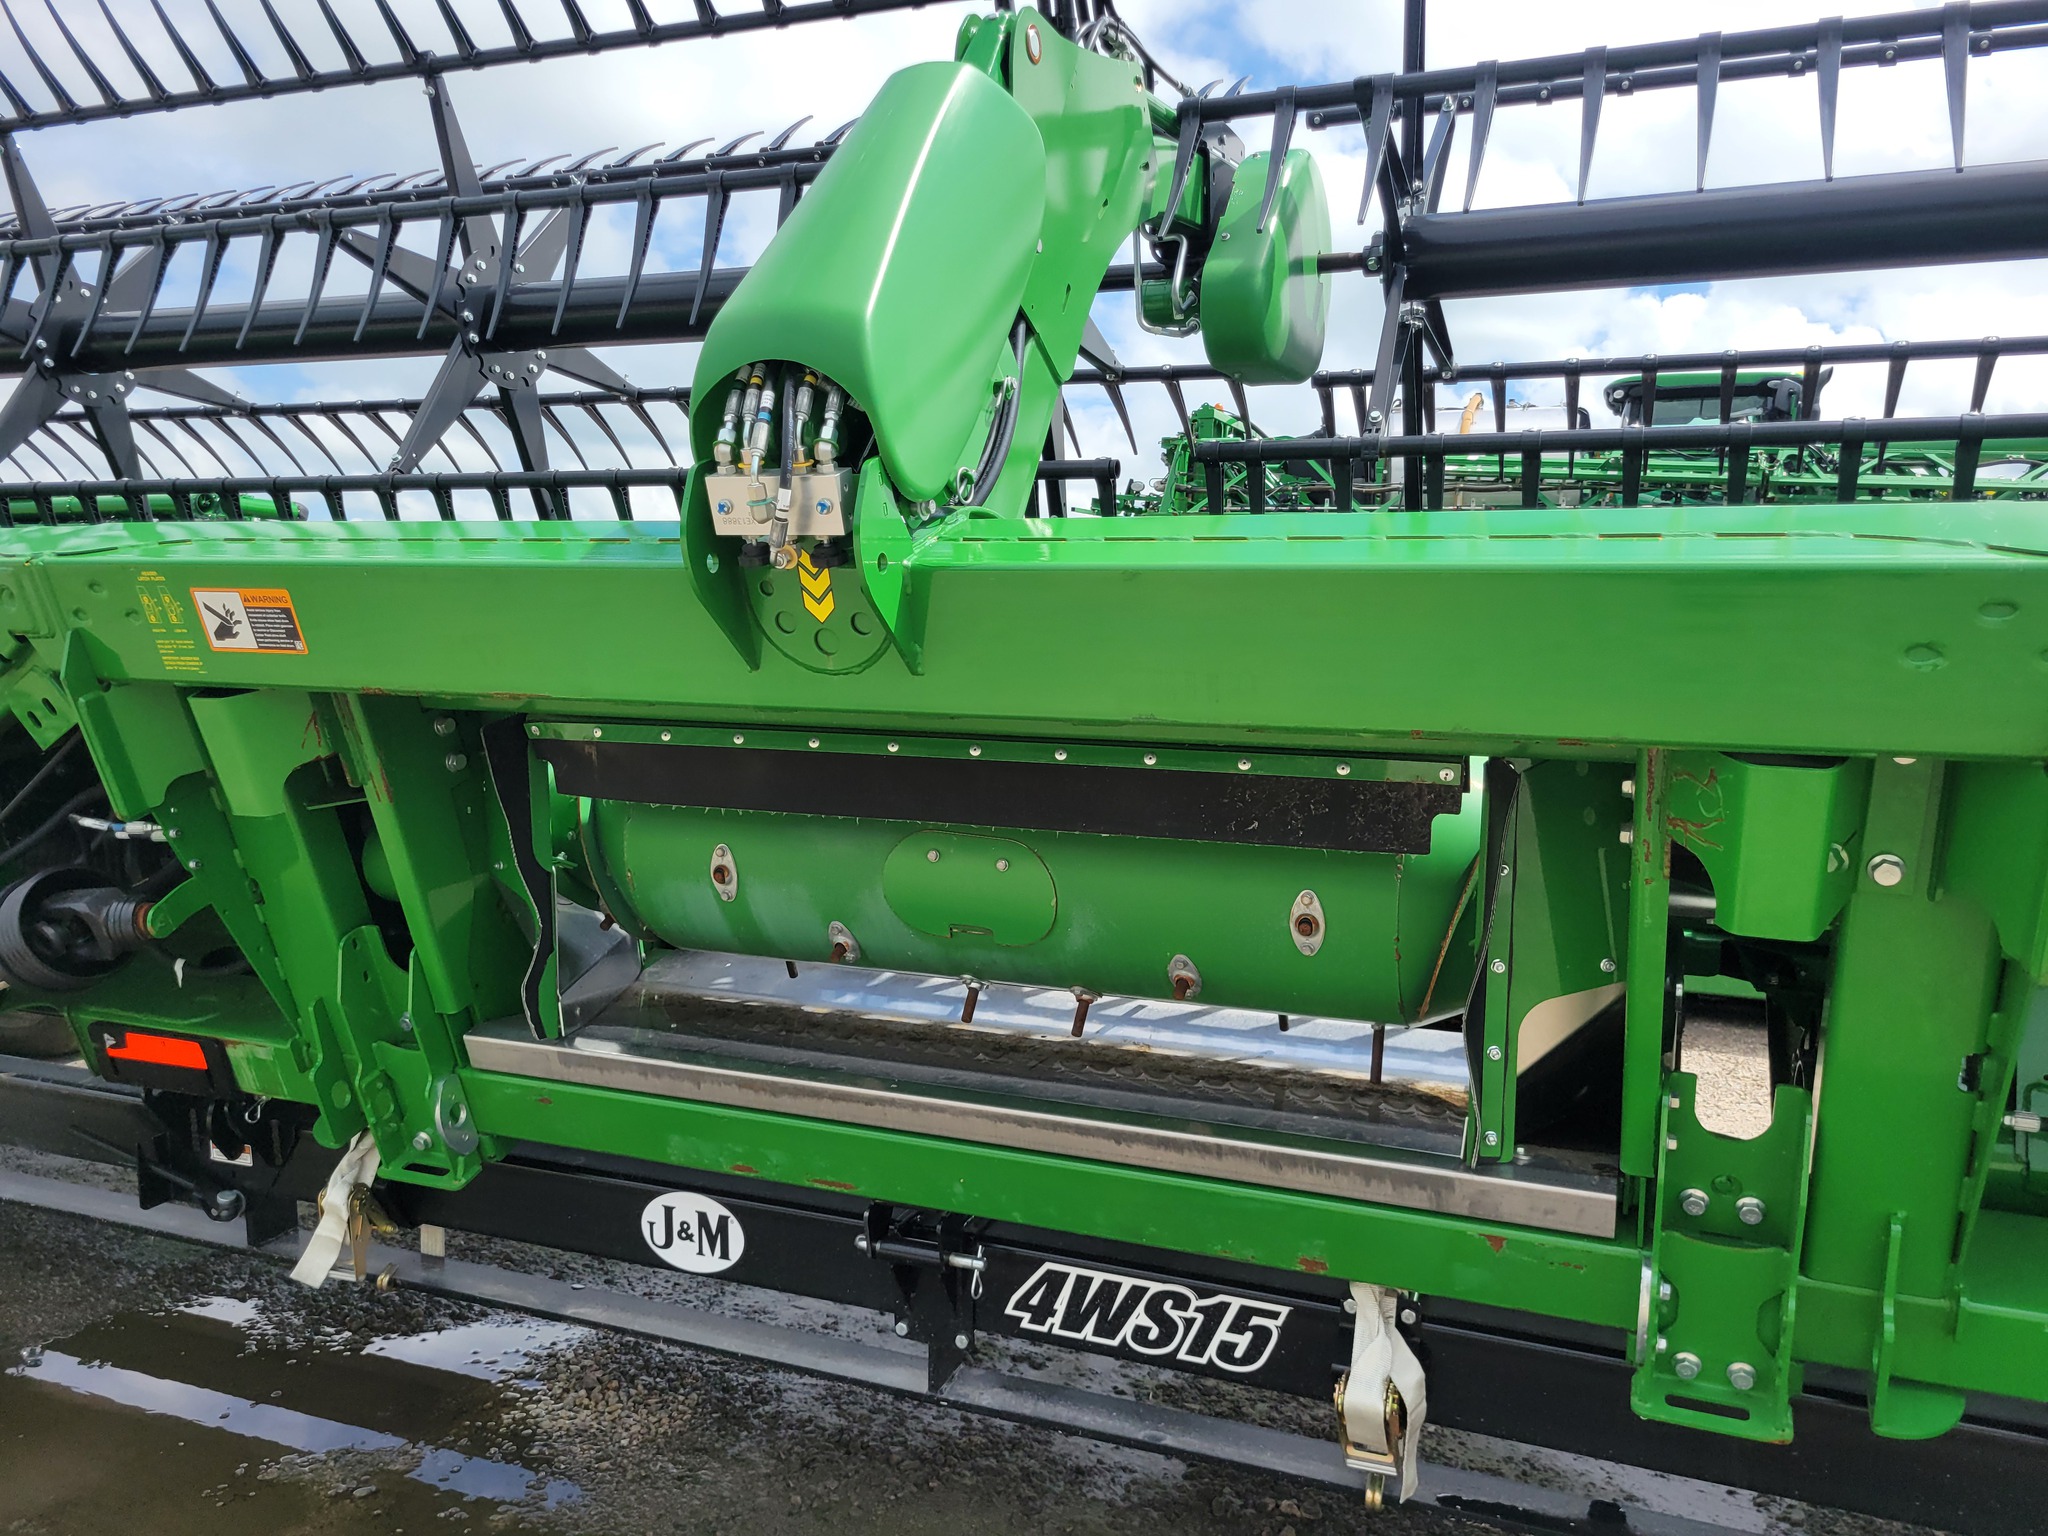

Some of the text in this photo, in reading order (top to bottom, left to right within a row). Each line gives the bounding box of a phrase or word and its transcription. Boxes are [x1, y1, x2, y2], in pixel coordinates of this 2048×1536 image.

[250, 595, 288, 604] WARNING
[646, 1204, 732, 1261] J&M
[1004, 1261, 1294, 1373] 4WS15
